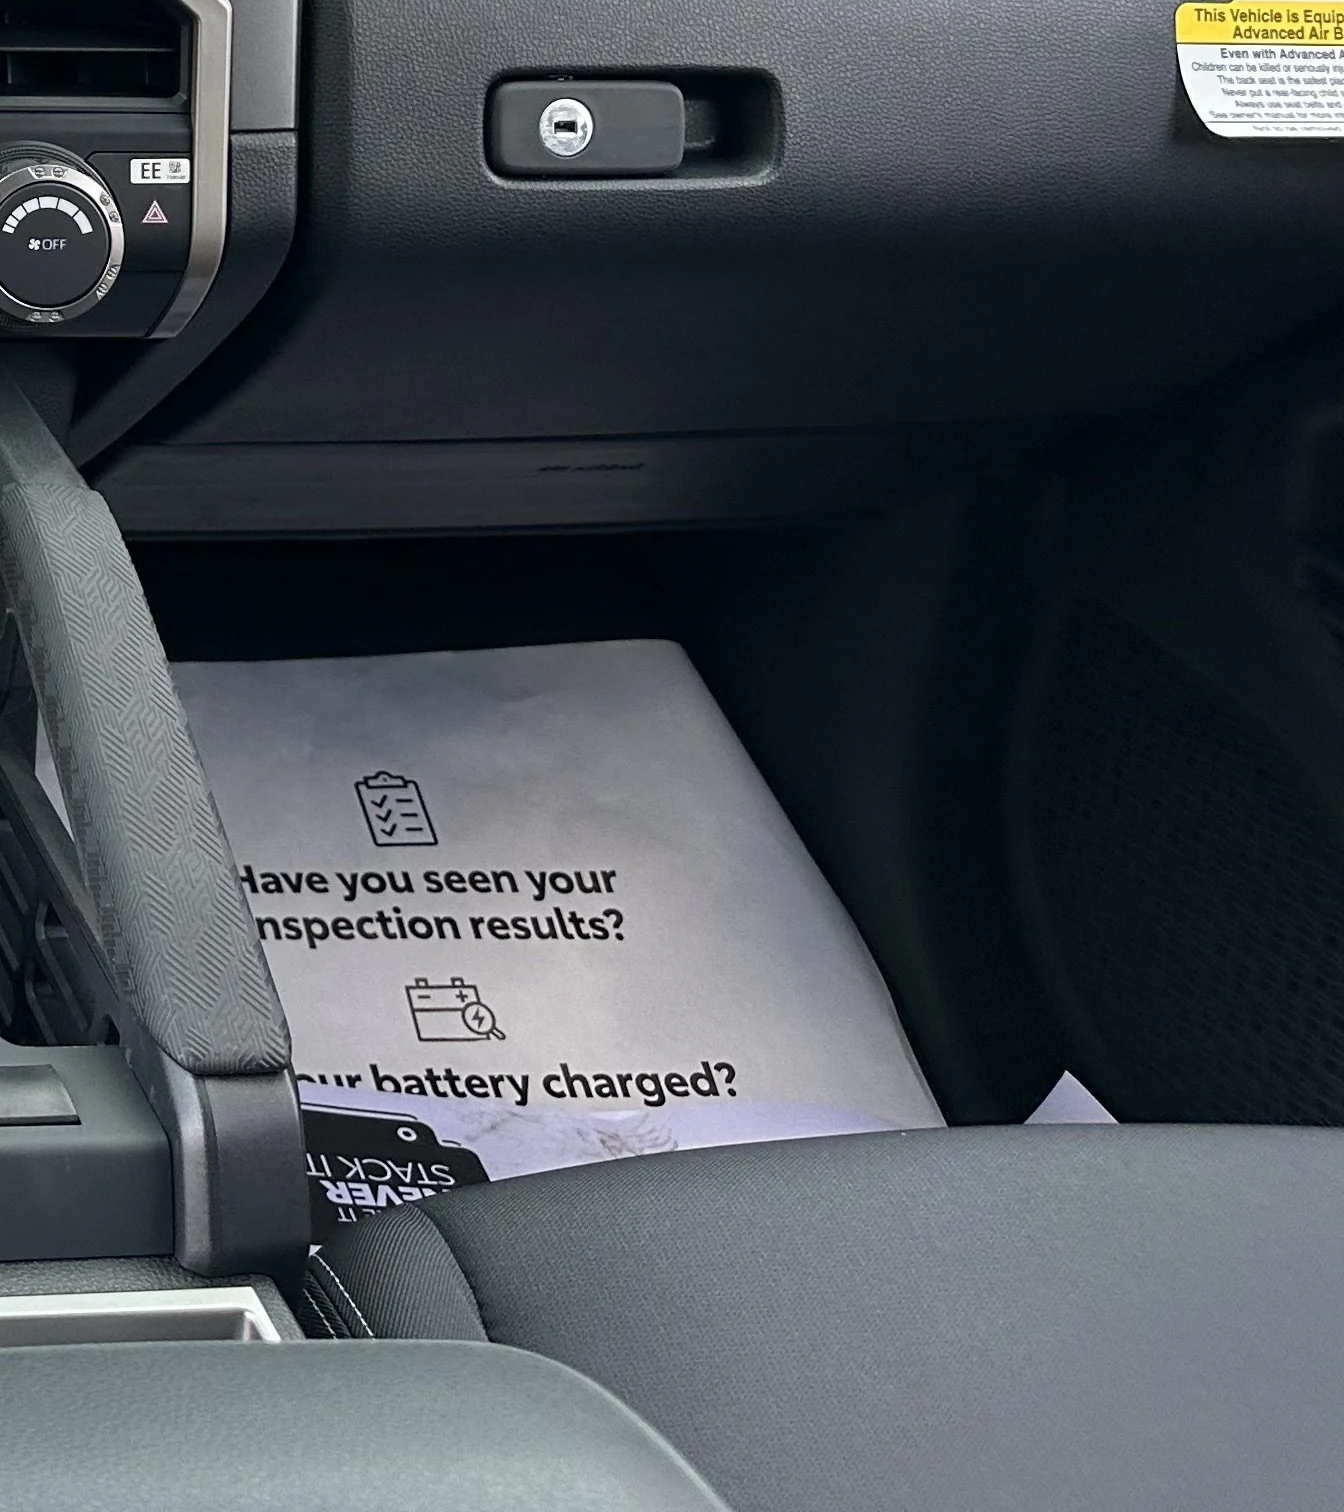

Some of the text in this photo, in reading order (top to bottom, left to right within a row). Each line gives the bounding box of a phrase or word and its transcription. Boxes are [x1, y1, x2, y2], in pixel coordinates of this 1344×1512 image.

[1194, 8, 1226, 23] This
[1229, 9, 1282, 23] Vehicle
[1287, 9, 1299, 23] is
[1233, 26, 1305, 40] Advanced
[1309, 26, 1329, 40] Air
[1220, 48, 1336, 59] Even with Advanced
[1192, 62, 1227, 71] Children
[1246, 63, 1257, 72] be
[1259, 63, 1281, 72] killed
[1294, 64, 1330, 74] seriously
[1217, 75, 1235, 84] The
[1236, 76, 1256, 84] back
[1259, 76, 1276, 84] seat
[1287, 76, 1301, 84] the
[1303, 76, 1327, 84] safest
[140, 162, 161, 179] EE
[42, 239, 67, 250] OFF
[341, 867, 413, 901] you
[423, 867, 519, 894] seen
[525, 868, 616, 901] your
[471, 907, 625, 942] results?
[369, 1061, 737, 1108] battery charged?
[306, 1153, 455, 1185] STACK IT
